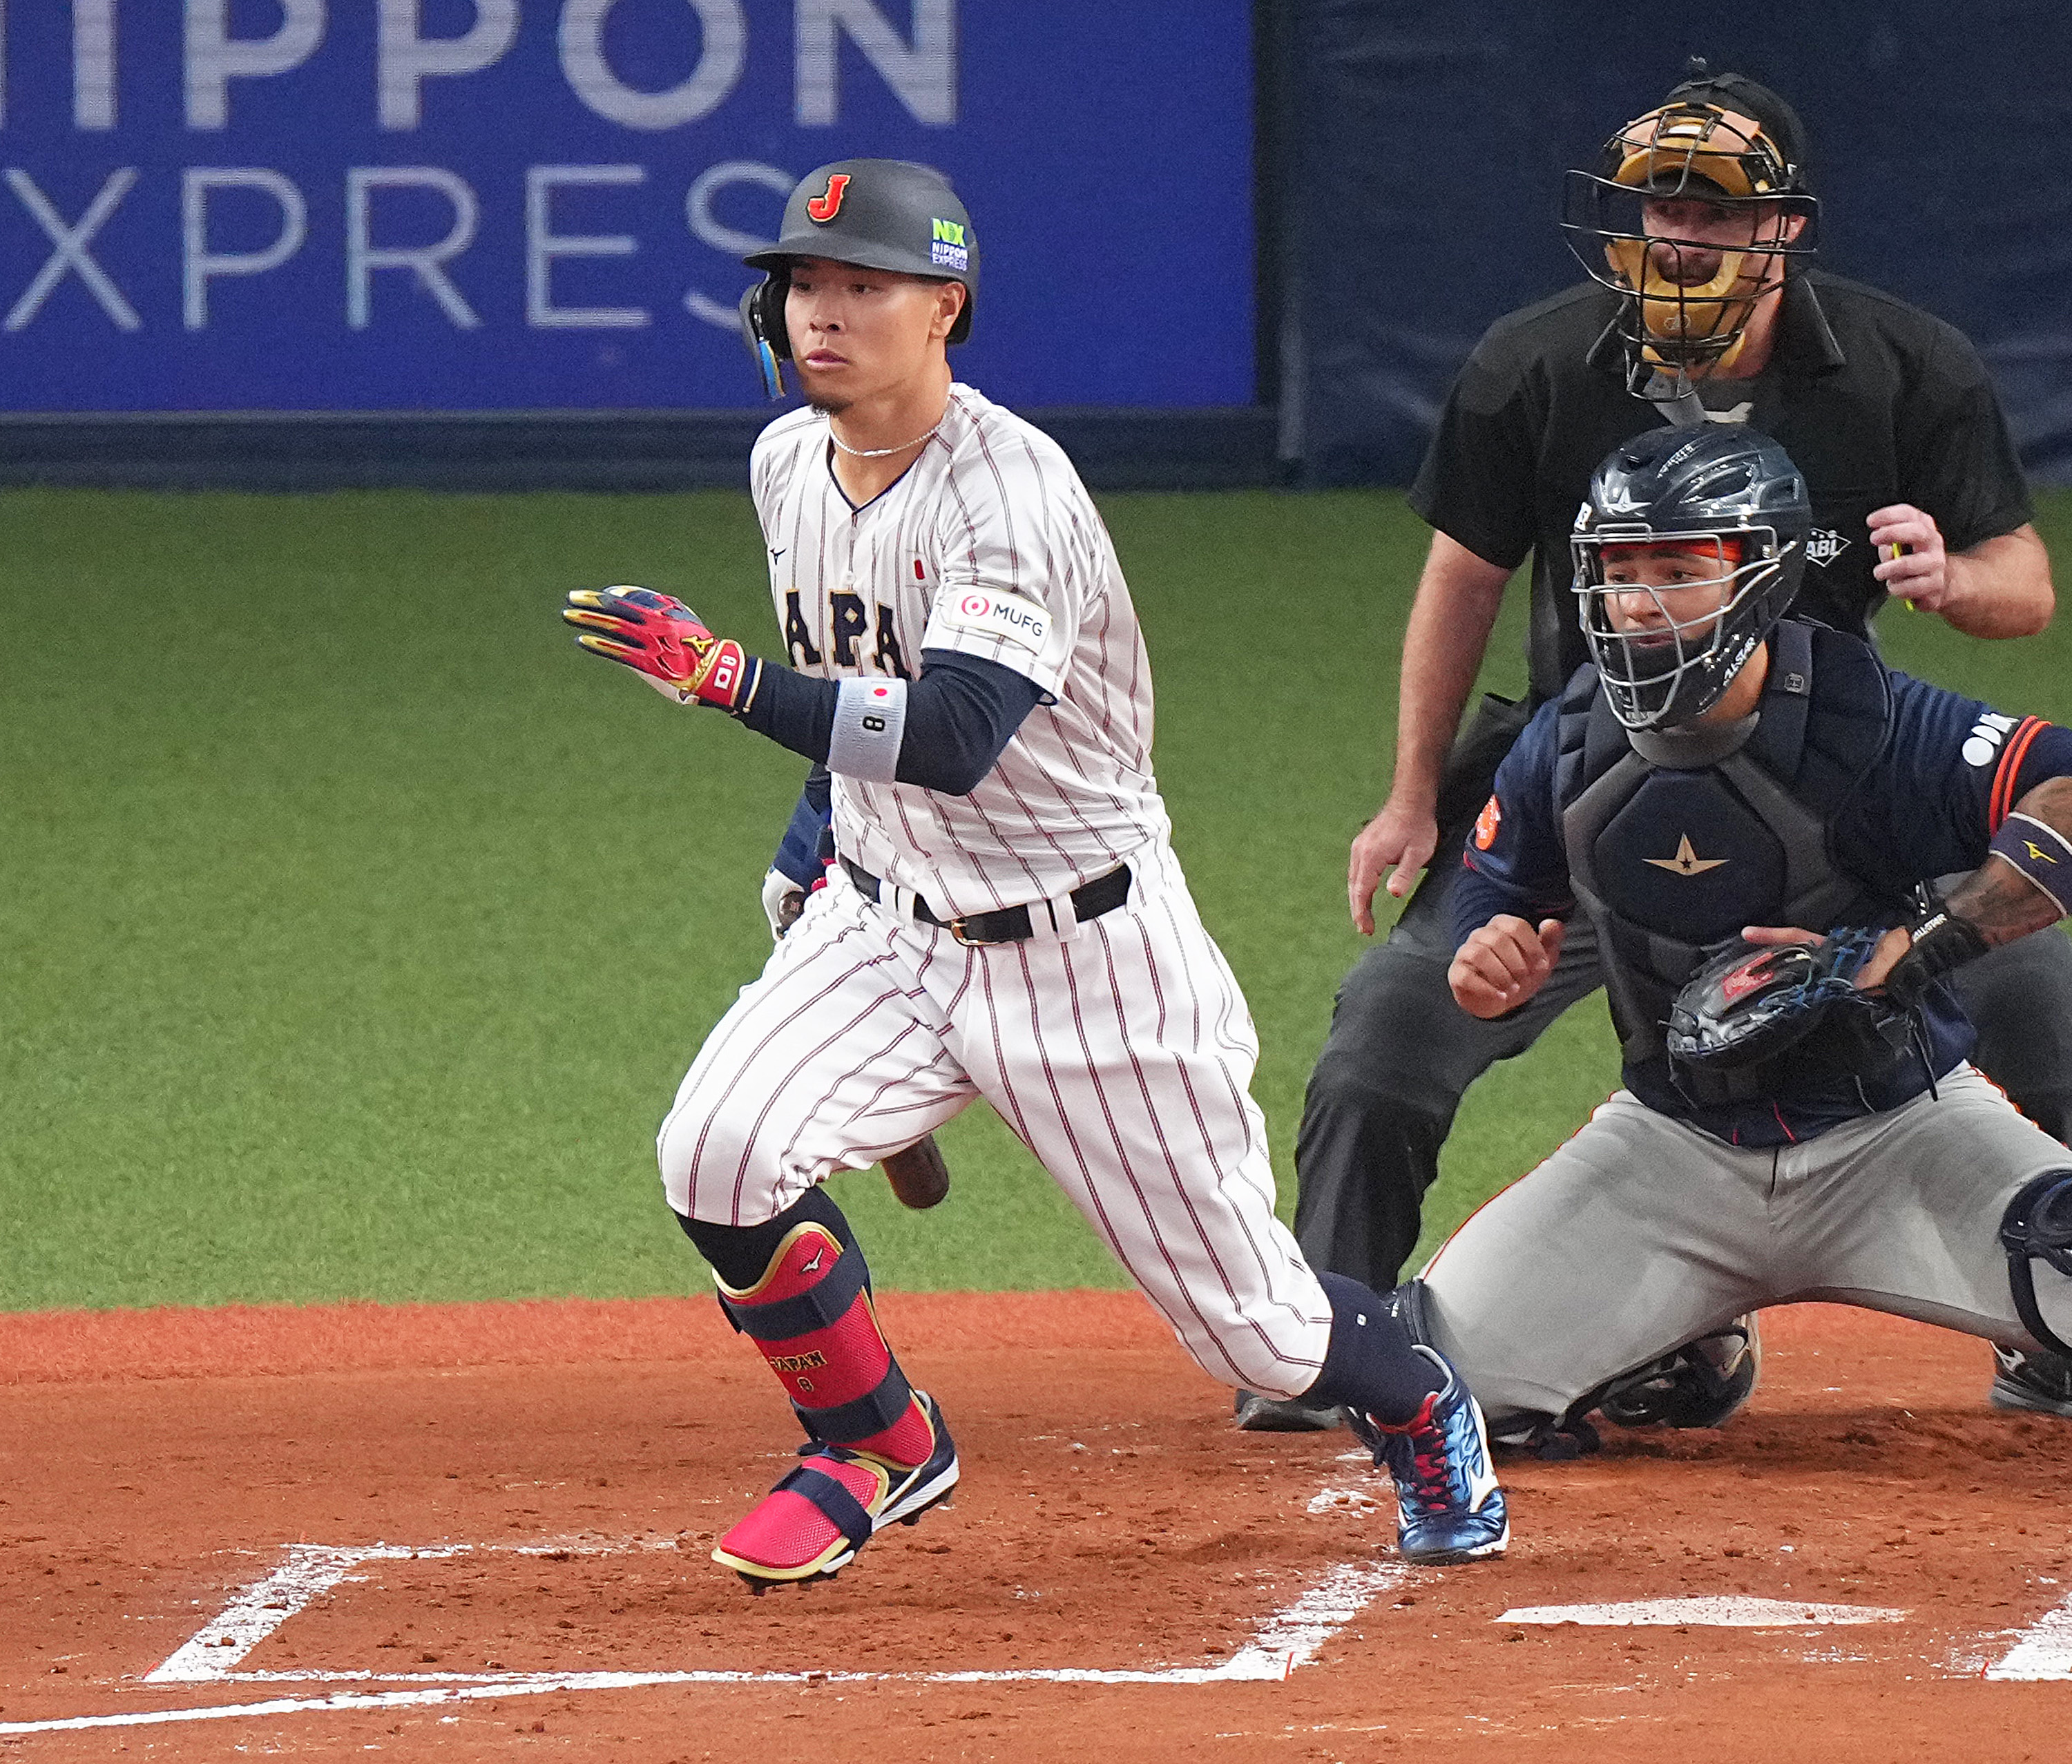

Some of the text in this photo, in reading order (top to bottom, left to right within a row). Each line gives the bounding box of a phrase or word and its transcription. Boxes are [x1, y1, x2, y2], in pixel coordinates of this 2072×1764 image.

[0, 0, 958, 130] IPPON
[806, 173, 852, 222] J
[3, 160, 805, 330] XPRES
[932, 218, 966, 247] NX
[932, 241, 968, 260] NIPPON
[932, 253, 968, 271] EXPRESS
[785, 588, 913, 680] APA
[992, 603, 1044, 637] MUFG
[863, 716, 885, 731] 8
